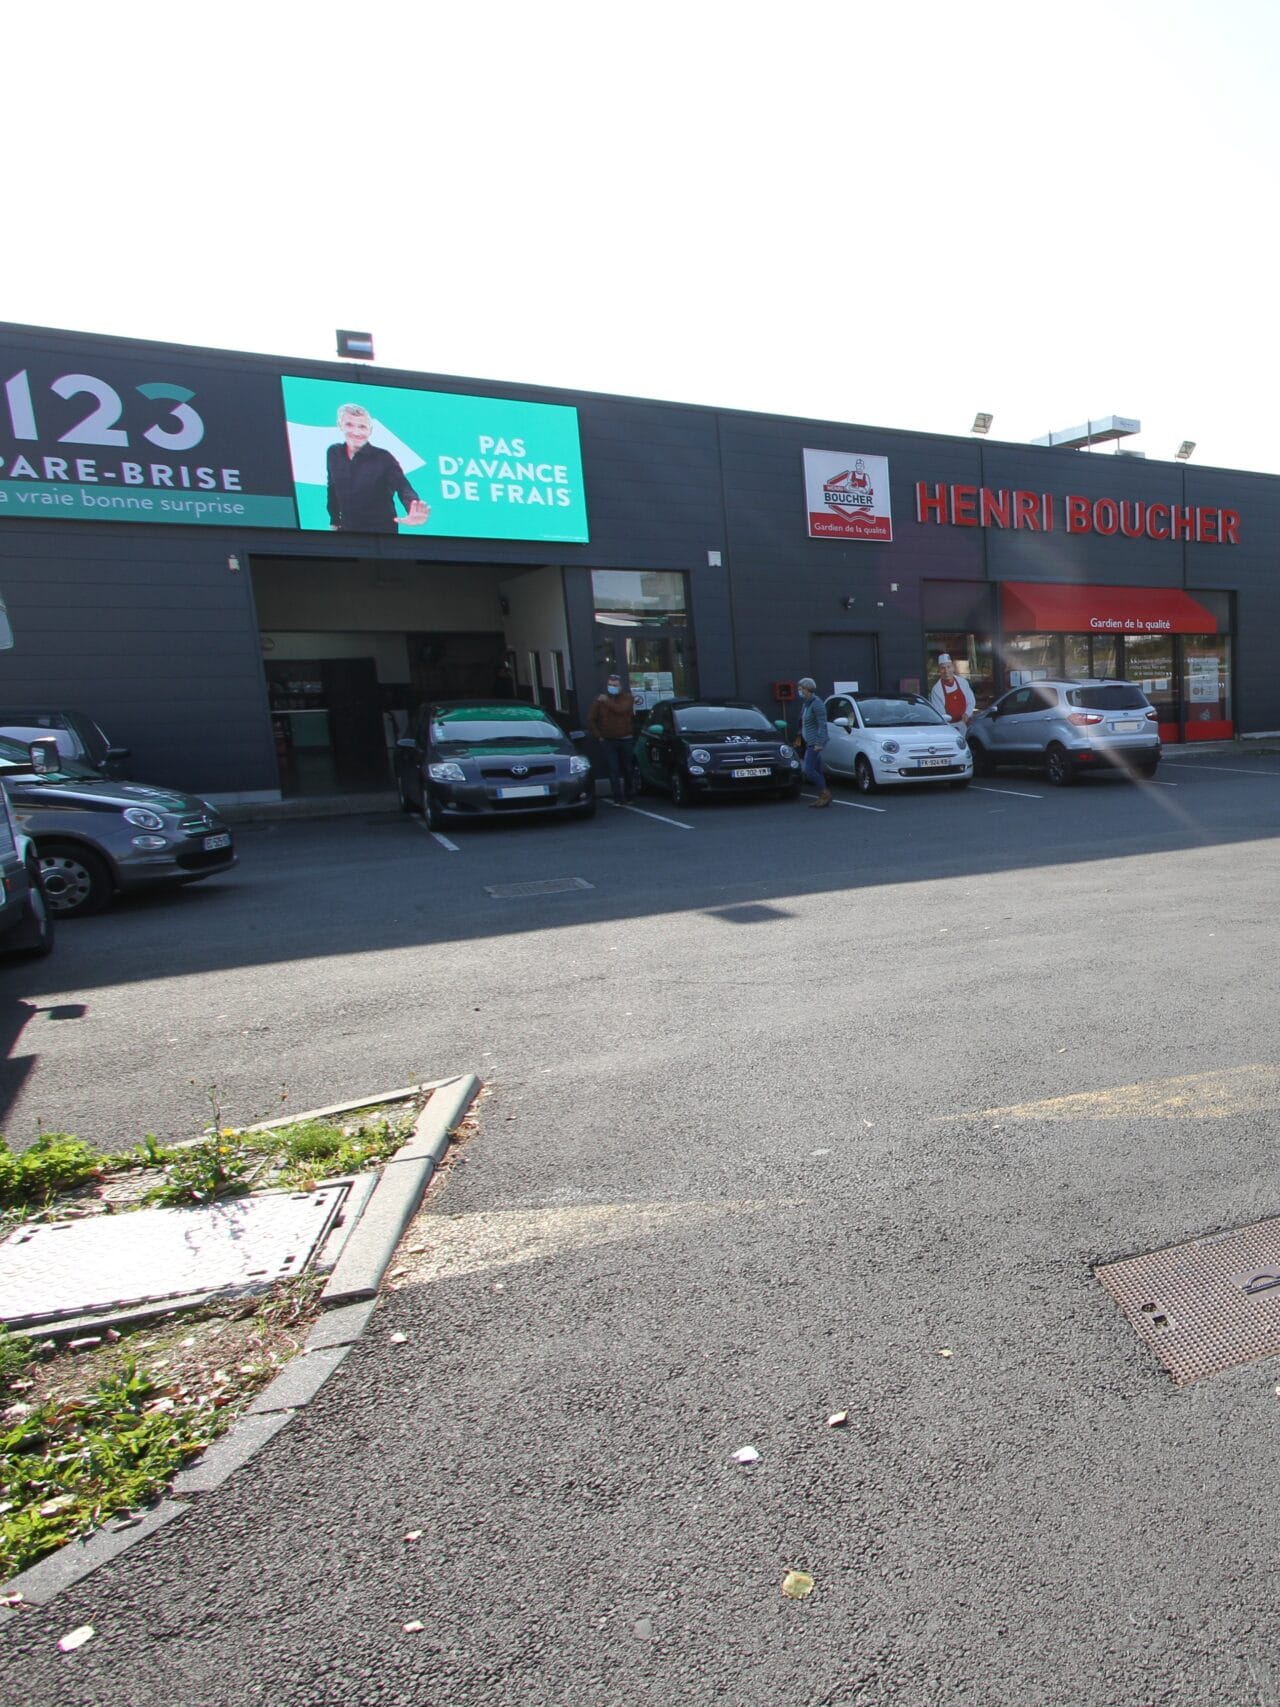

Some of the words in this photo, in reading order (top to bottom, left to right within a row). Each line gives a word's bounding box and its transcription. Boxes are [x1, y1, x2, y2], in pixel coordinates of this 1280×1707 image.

[5, 369, 205, 450] 123
[478, 435, 527, 458] PAS
[0, 454, 243, 491] ARE-BRISE
[438, 455, 569, 484] D'AVANCE
[0, 491, 8, 502] a
[16, 487, 74, 505] vraie
[81, 489, 153, 510] bonne
[161, 496, 245, 518] surprise
[441, 479, 480, 502] DE
[824, 492, 873, 505] BOUCHER
[915, 480, 1054, 532] HENRI
[1065, 495, 1241, 545] BOUCHER
[814, 522, 844, 532] Gardien
[845, 524, 855, 533] de
[856, 525, 862, 533] la
[864, 527, 887, 536] qualité
[1090, 617, 1122, 628] Gardien
[1124, 618, 1135, 629] de
[1136, 618, 1143, 629] la
[1145, 619, 1171, 631] qualité
